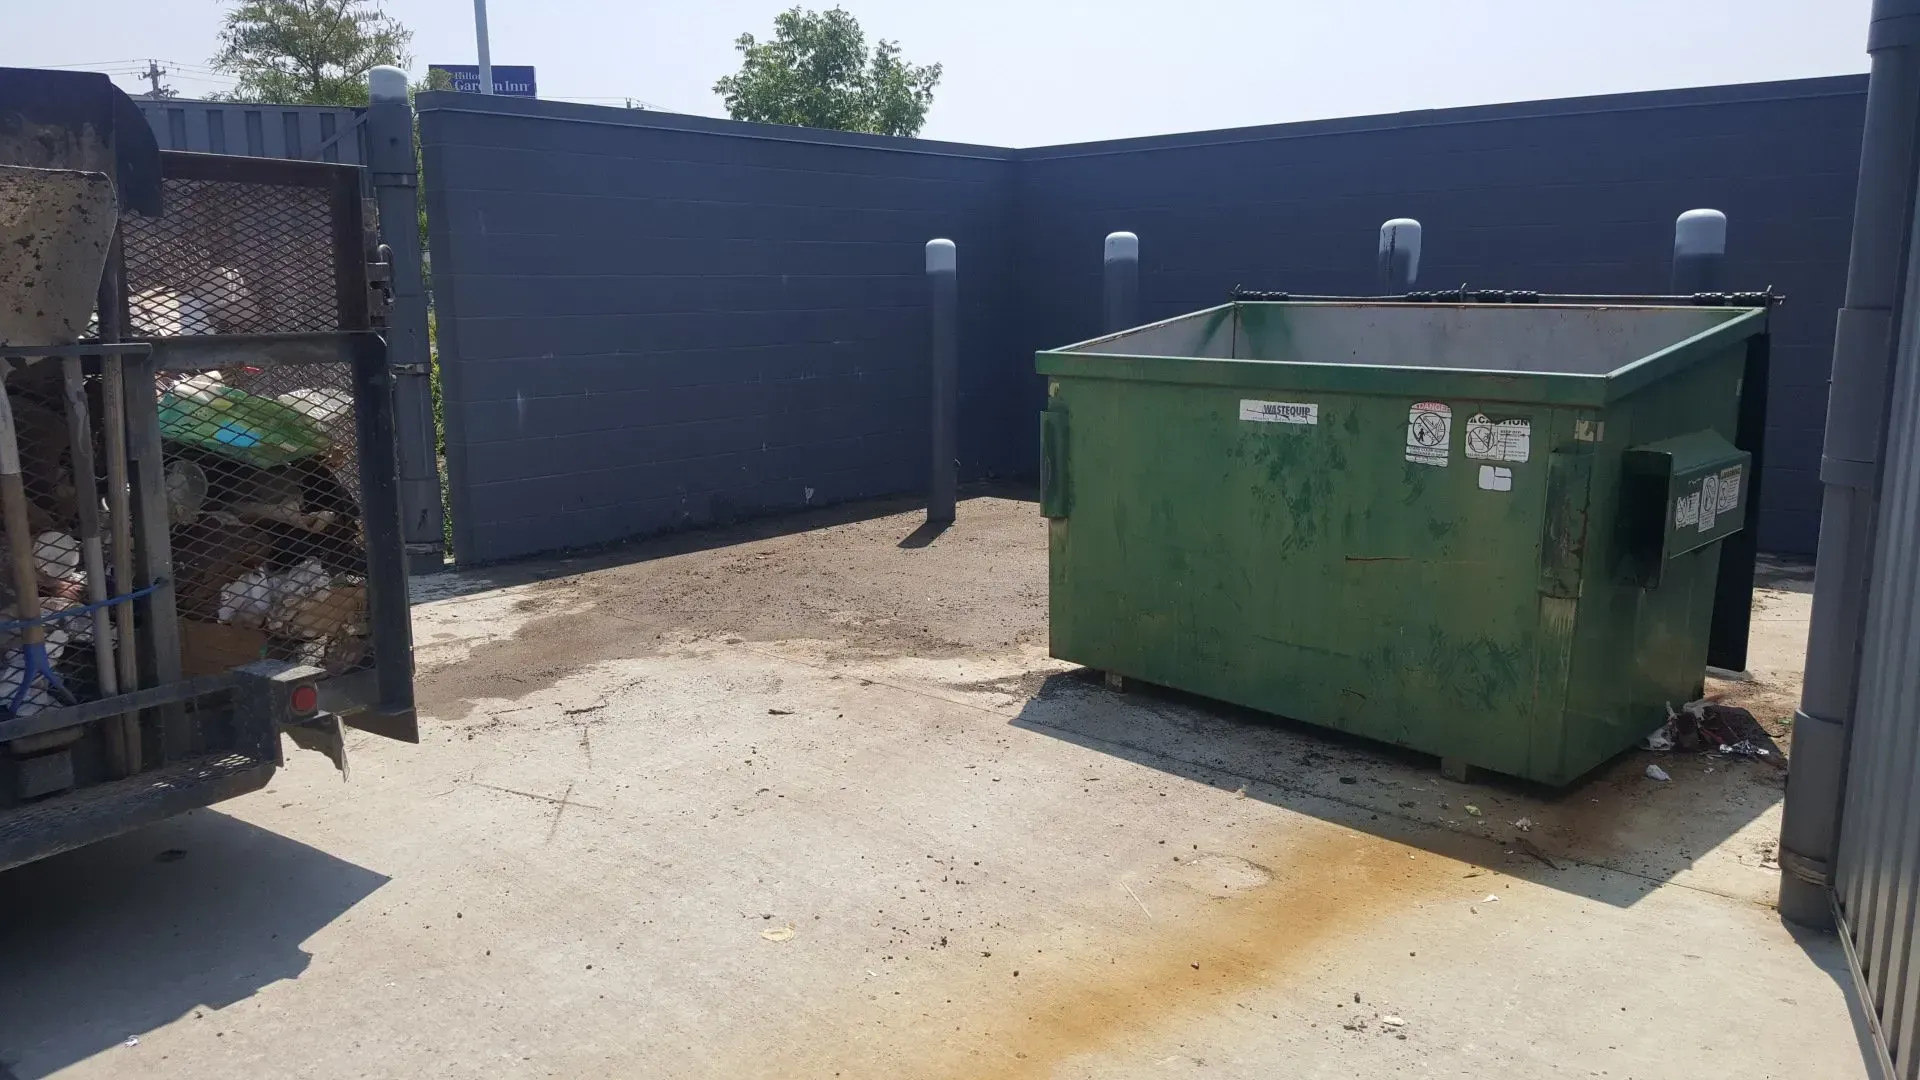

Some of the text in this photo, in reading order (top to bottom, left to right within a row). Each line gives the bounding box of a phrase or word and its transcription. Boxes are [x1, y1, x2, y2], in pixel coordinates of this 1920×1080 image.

[455, 71, 480, 80] Hilto
[455, 80, 528, 92] Garn Inn
[1264, 405, 1310, 417] WASTEQUIP
[1478, 416, 1528, 426] CION
